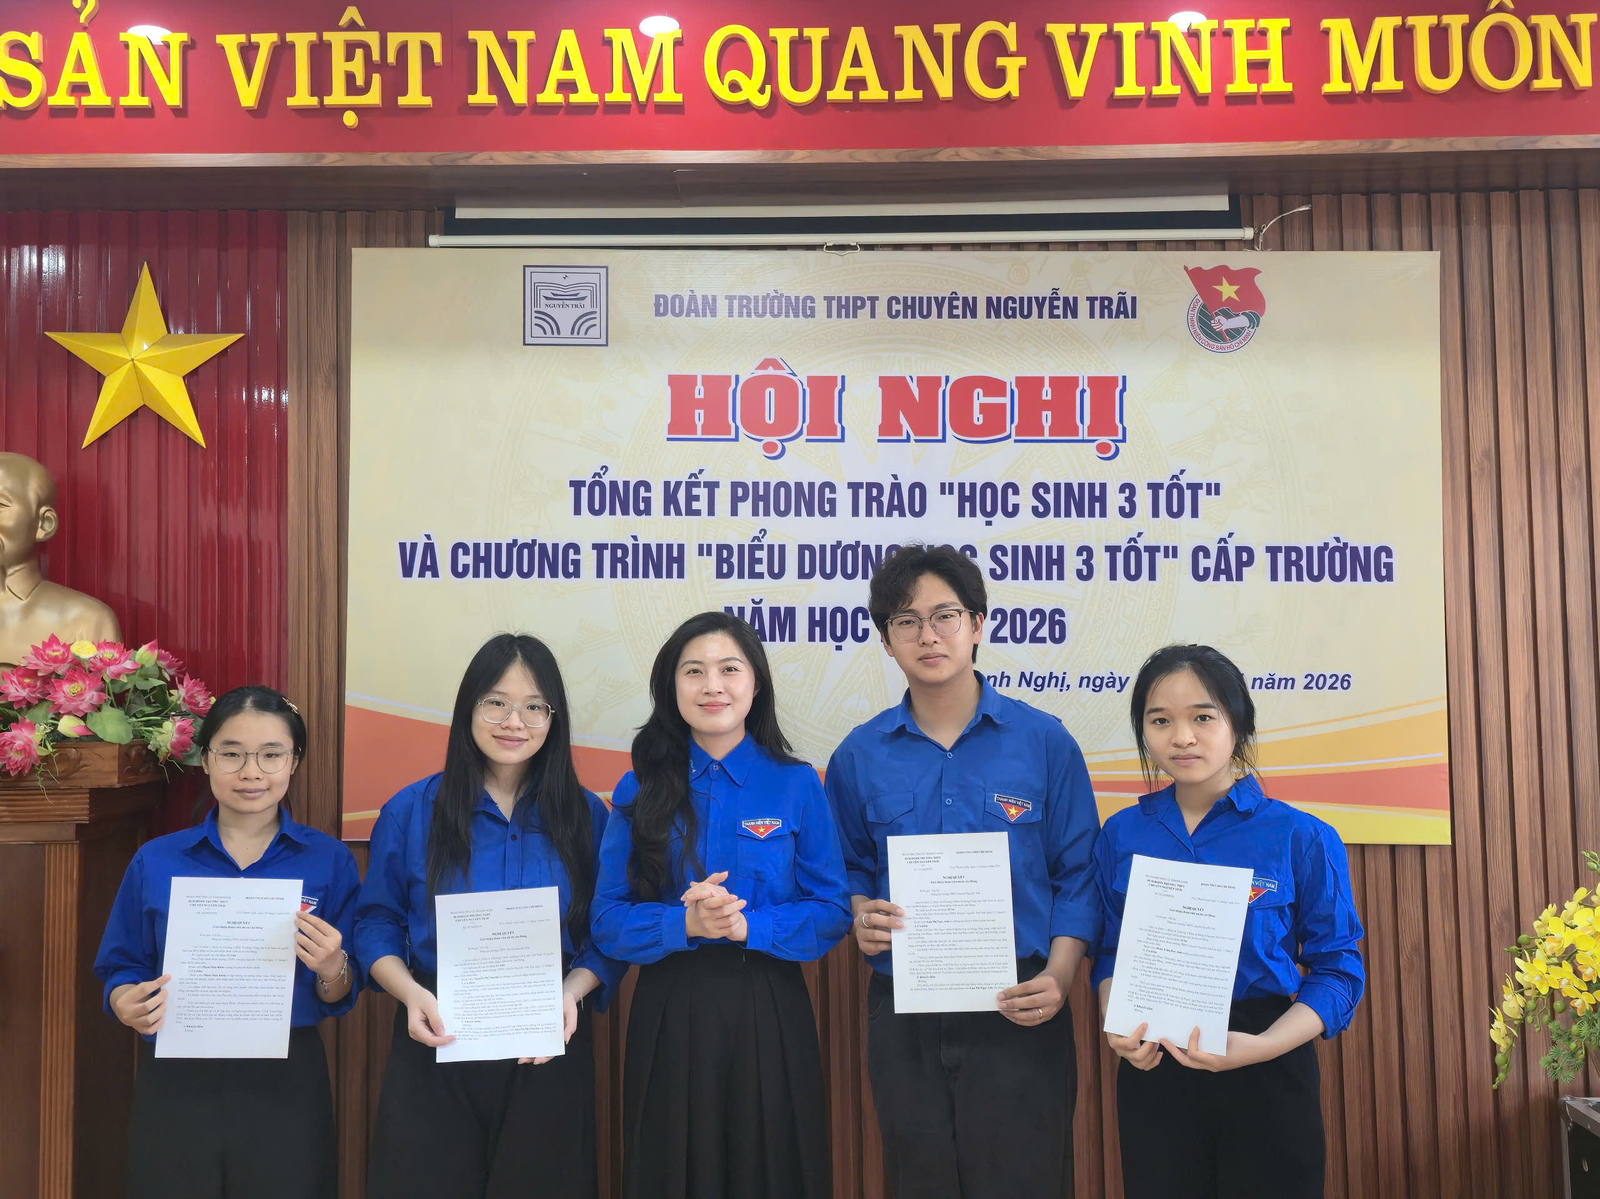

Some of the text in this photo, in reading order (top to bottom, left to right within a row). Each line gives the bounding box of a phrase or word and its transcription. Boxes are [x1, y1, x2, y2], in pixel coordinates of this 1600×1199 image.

[215, 6, 442, 129] VIỆT
[467, 29, 684, 108] NAM
[703, 20, 1027, 109] QUANG
[1046, 17, 1293, 99] VINH
[654, 288, 1138, 320] ĐOÀN TRƯỜNG THPT CHUYÊN NGUYỄN TRÃI
[666, 357, 1127, 461] HỘI NGHỊ
[569, 465, 1221, 526] TỔNG KẾT PHONG TRÀO "HỌC SINH 3 TỐT"
[399, 528, 1394, 582] VÀ CHƯƠNG TRÌNH "BIỂU DƯƠN SINH 3 TỐT" CẤP TRƯỜNG
[808, 606, 870, 651] HỌC
[990, 607, 1067, 644] 2026
[1018, 671, 1070, 693] Nghị,
[1079, 671, 1130, 693] ngày
[1251, 672, 1296, 690] năm
[1303, 673, 1352, 690] 2026
